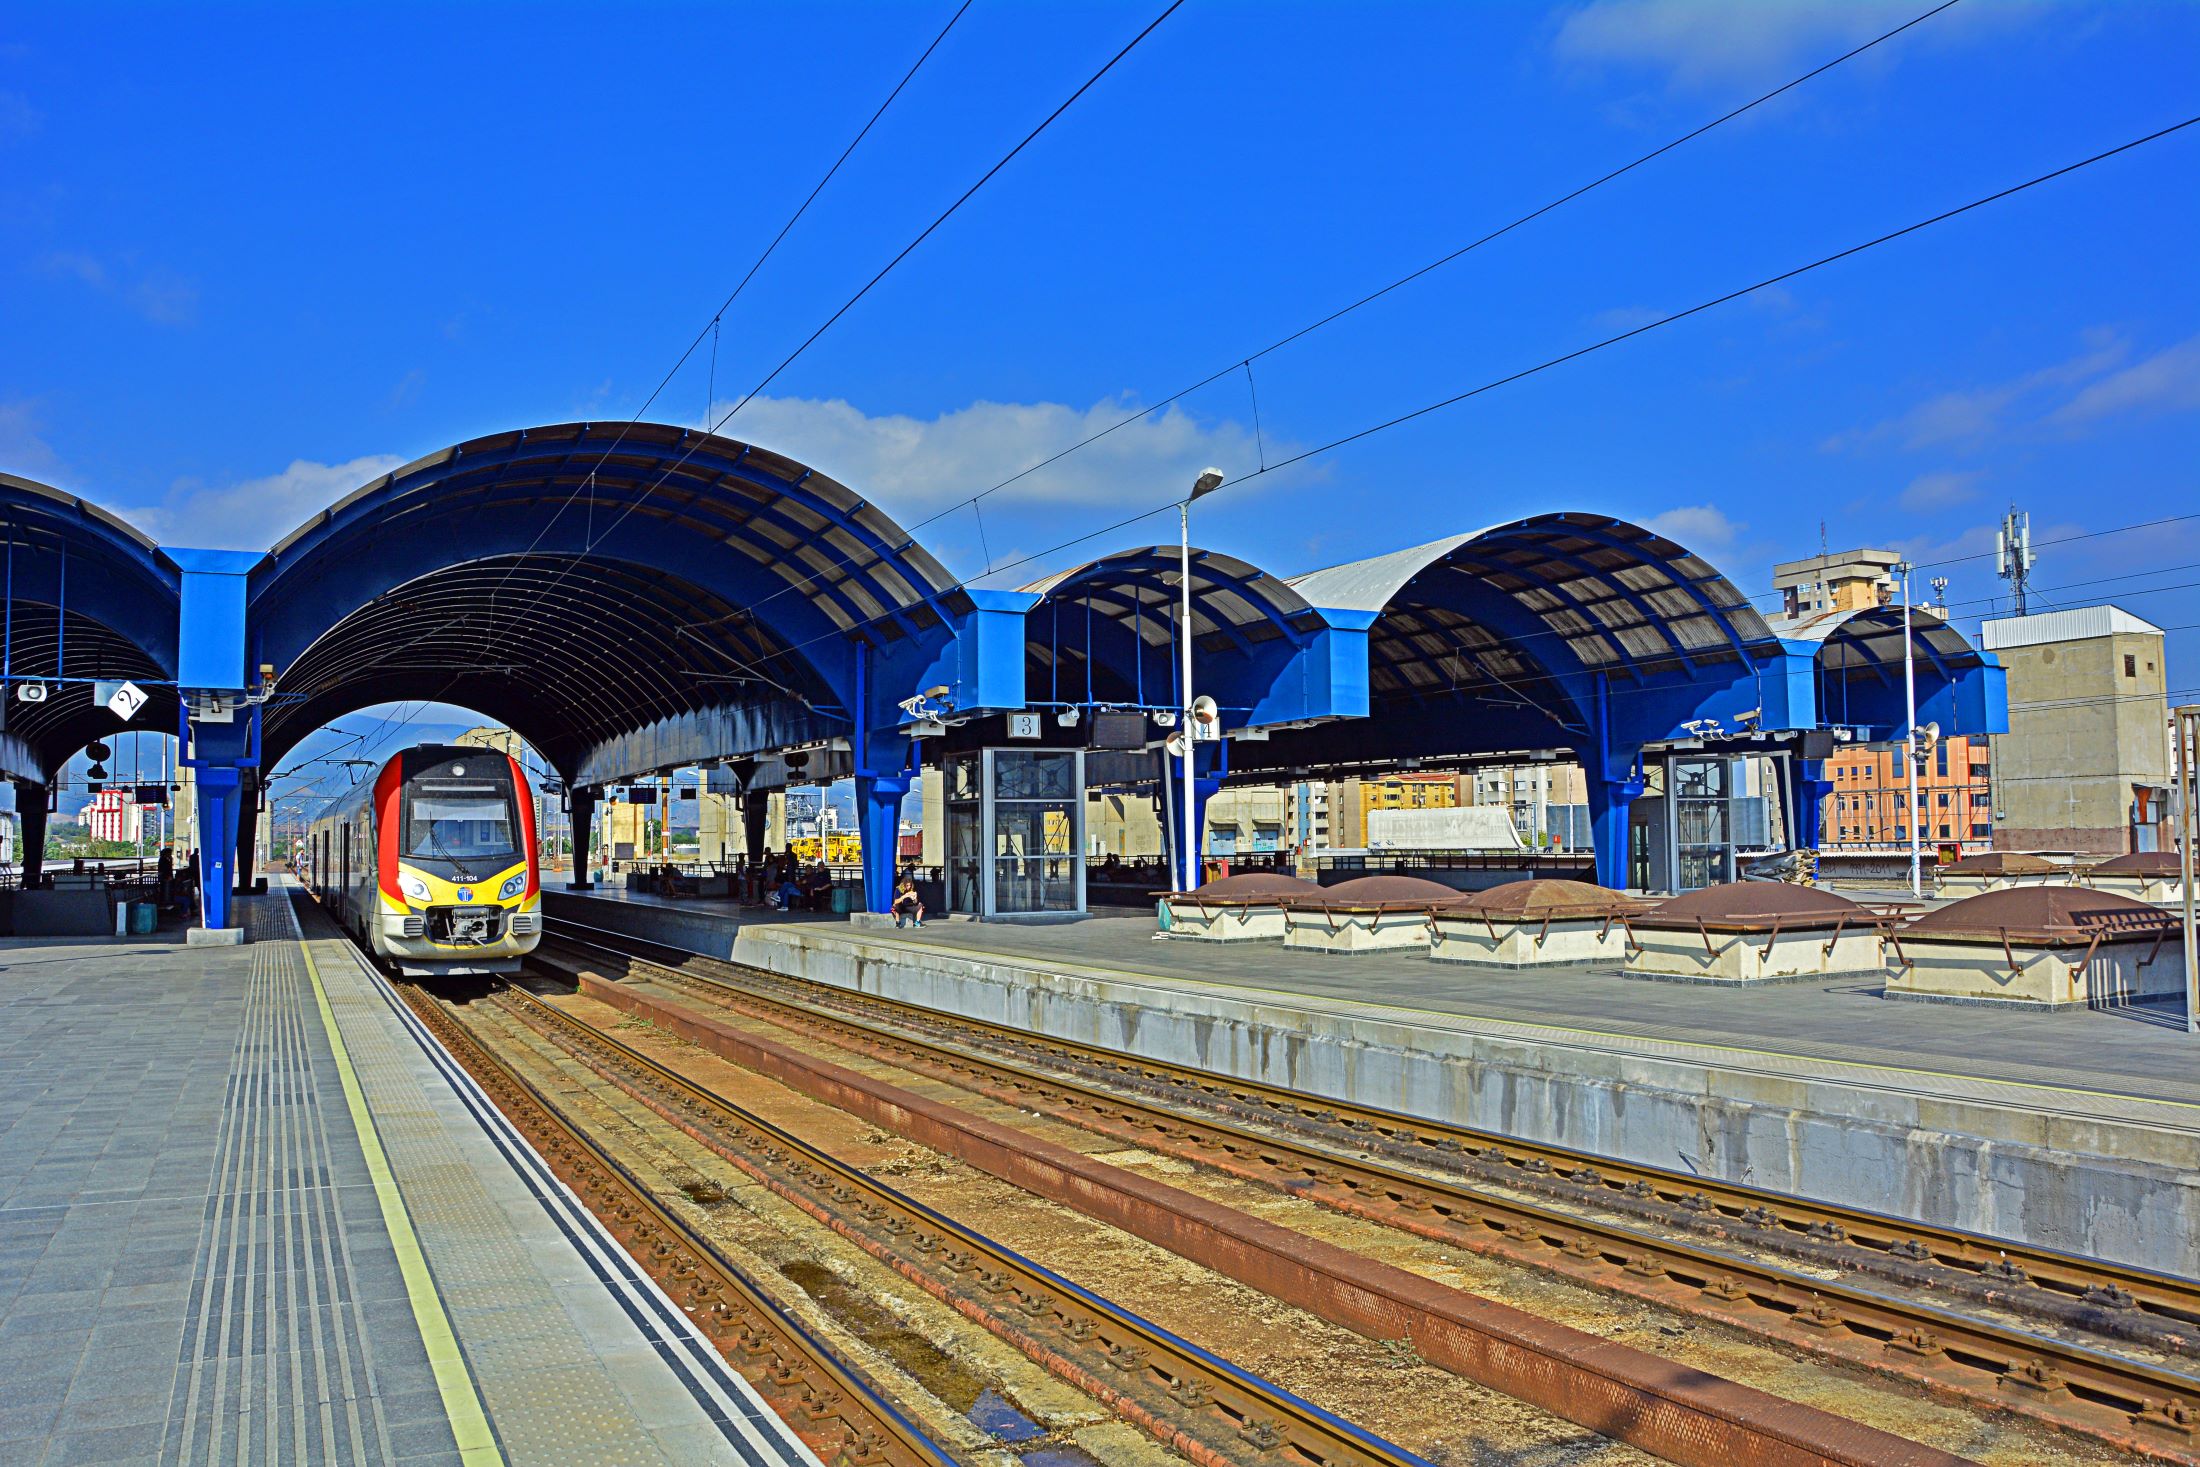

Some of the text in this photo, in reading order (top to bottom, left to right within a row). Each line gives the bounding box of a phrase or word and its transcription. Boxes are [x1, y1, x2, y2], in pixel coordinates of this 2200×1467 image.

[118, 690, 140, 711] 2
[1022, 716, 1031, 735] 3
[1203, 723, 1212, 737] 4
